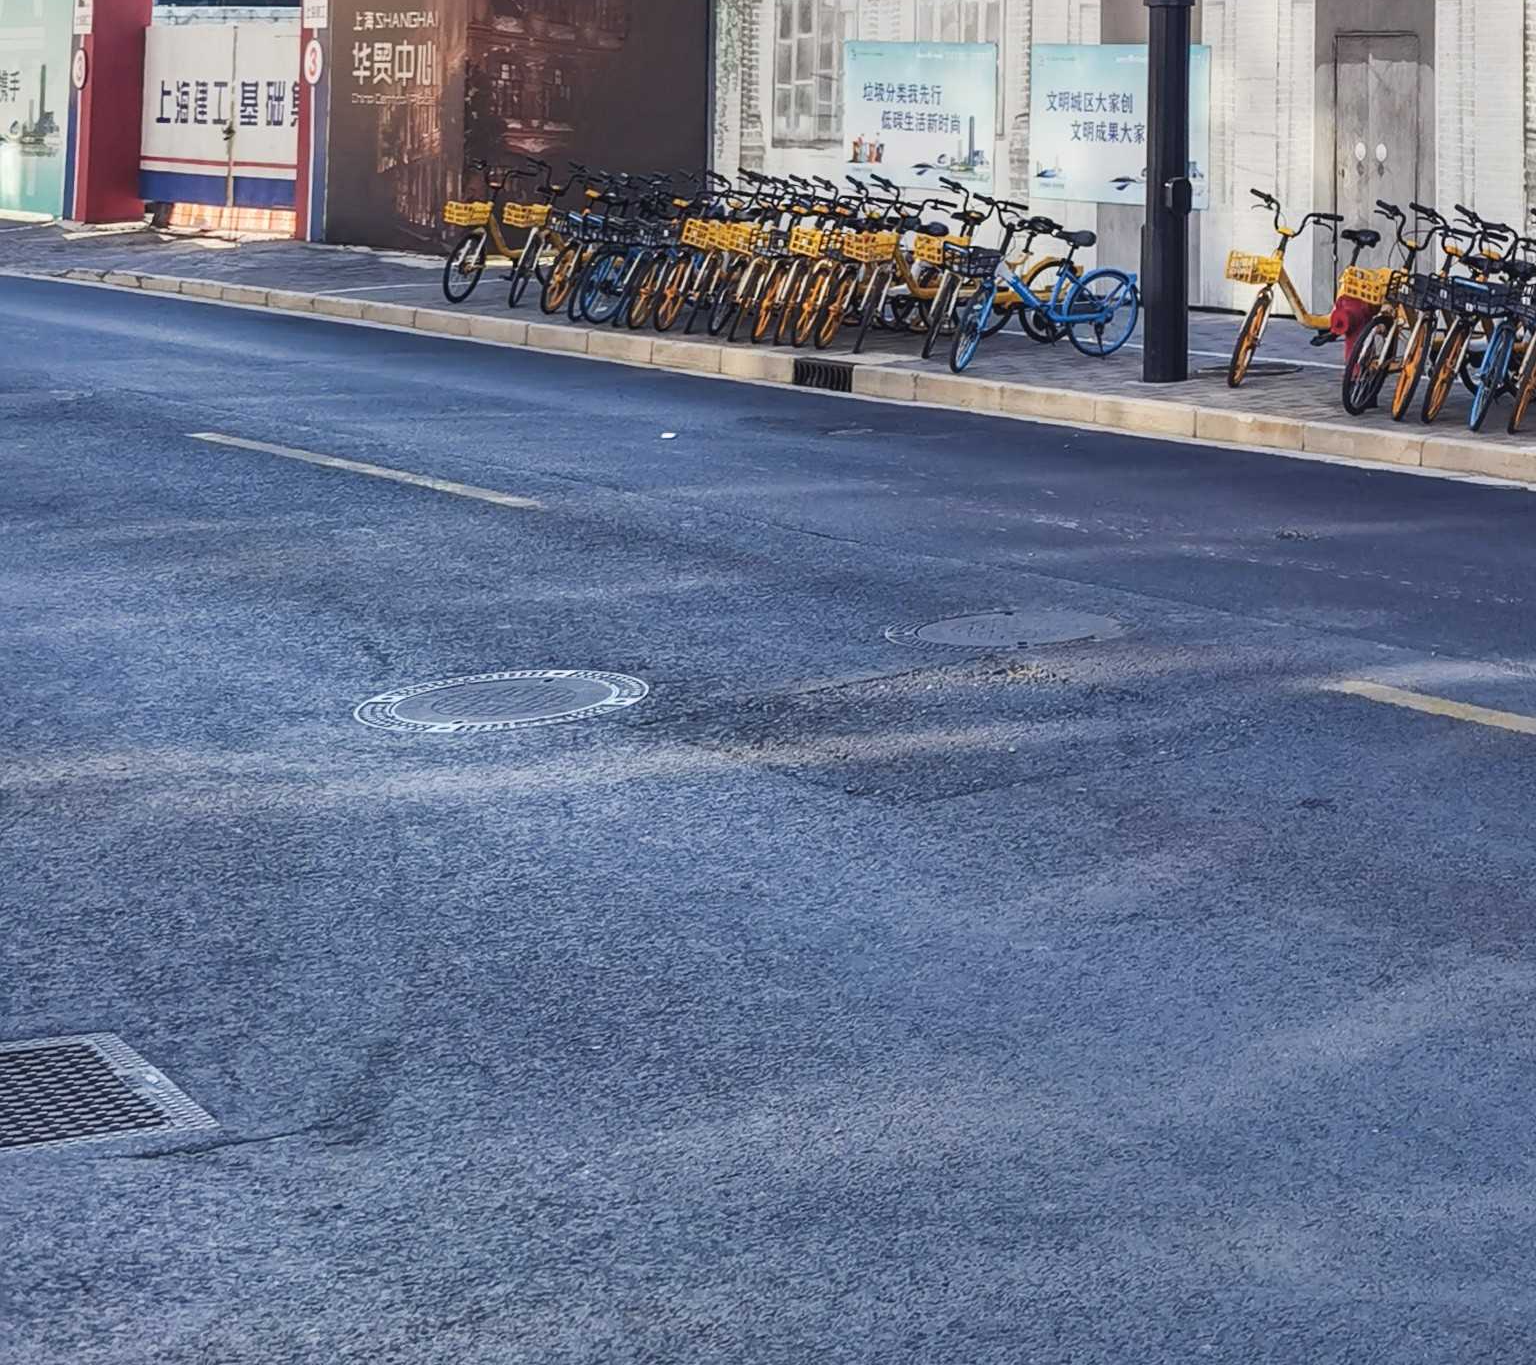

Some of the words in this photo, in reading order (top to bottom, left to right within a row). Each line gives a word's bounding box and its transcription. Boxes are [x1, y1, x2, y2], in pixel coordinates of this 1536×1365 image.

[1045, 91, 1134, 114] 文明城区大家创
[1070, 120, 1145, 144] 文明成果大家
